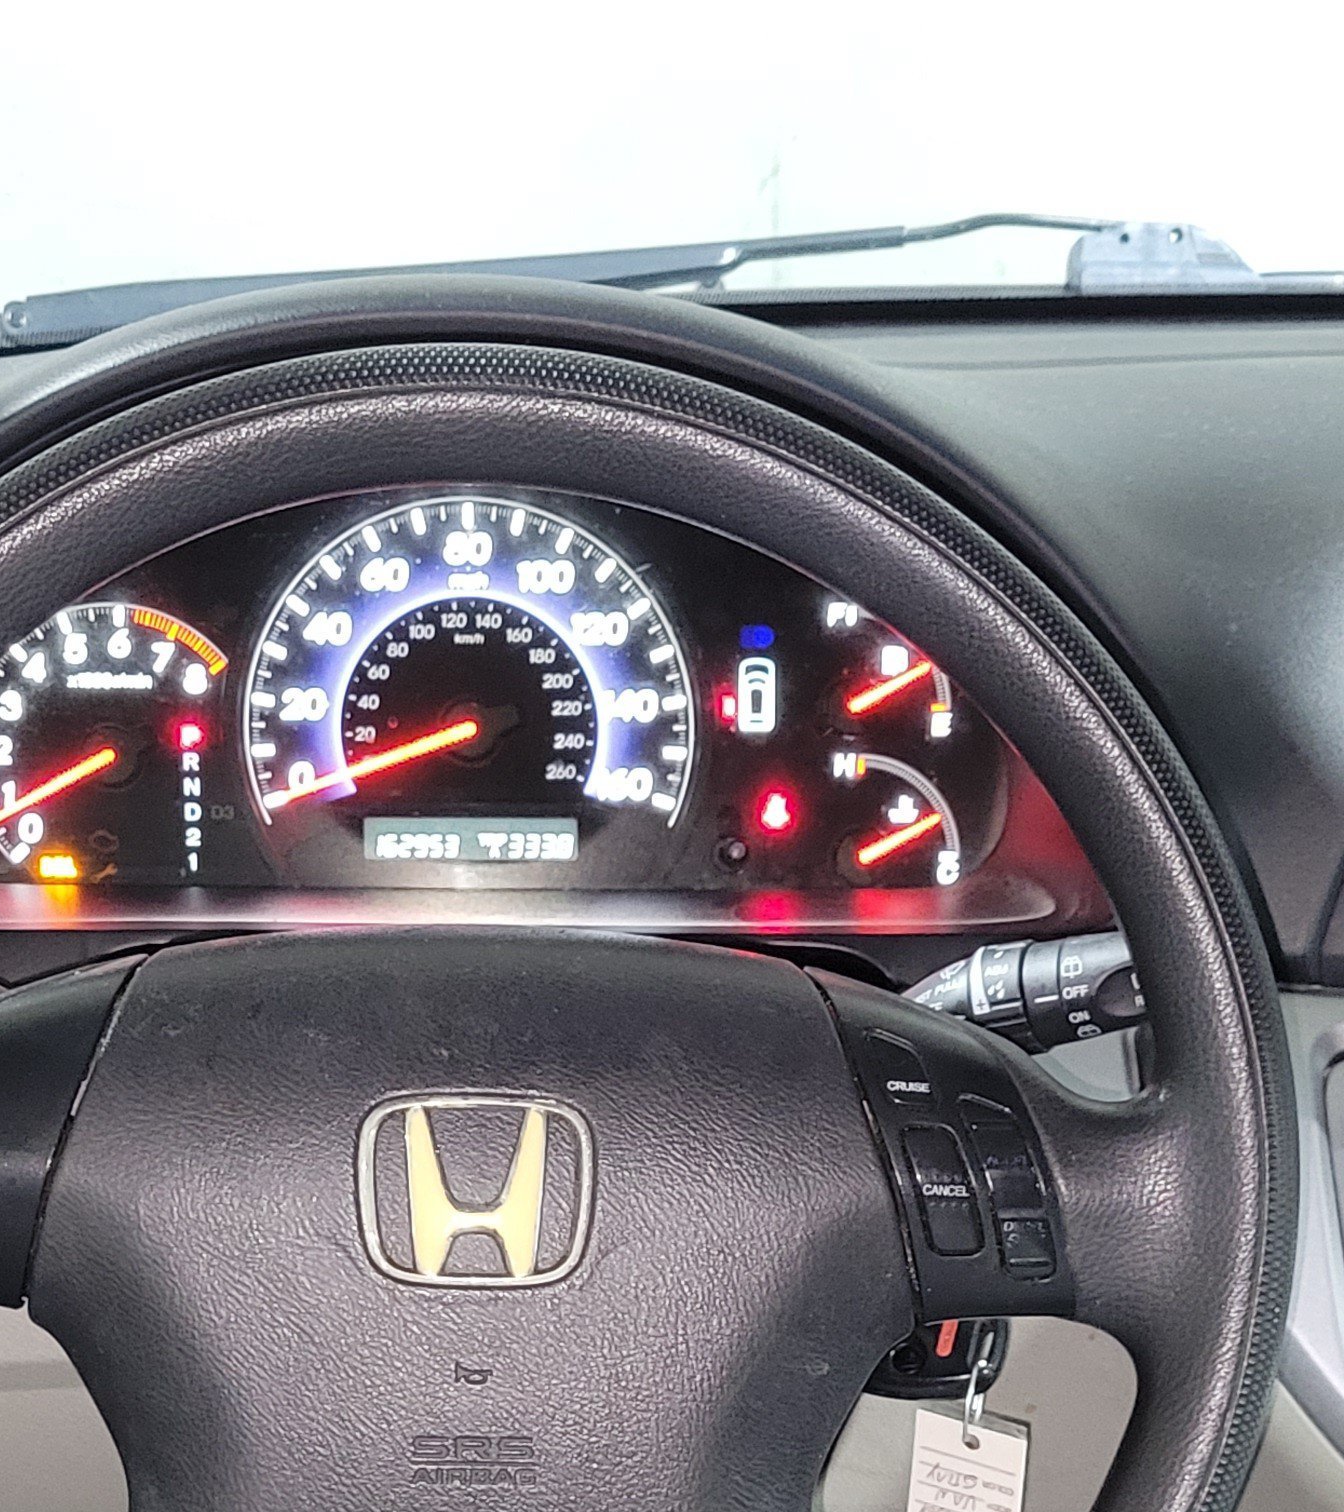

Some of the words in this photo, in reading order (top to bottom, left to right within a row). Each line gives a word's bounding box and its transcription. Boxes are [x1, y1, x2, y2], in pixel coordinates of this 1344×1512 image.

[442, 532, 492, 565] 80
[360, 558, 410, 591] 60
[516, 560, 575, 593] 100
[303, 612, 352, 645] 40
[441, 613, 467, 628] 120
[475, 613, 502, 629] 140
[571, 612, 628, 645] 120
[409, 624, 435, 640] 100
[454, 632, 484, 645] km/h
[506, 627, 532, 643] 160
[63, 633, 88, 664] 5
[108, 629, 131, 658] 6
[386, 643, 409, 658] 80
[151, 642, 176, 672] 7
[529, 649, 555, 664] 180
[22, 653, 47, 683] 4
[367, 665, 390, 681] 60
[183, 664, 207, 694] 8
[542, 673, 574, 690] 200
[280, 688, 329, 720] 20
[357, 695, 380, 710] 40
[551, 701, 582, 717] 220
[600, 689, 658, 722] 140
[354, 727, 376, 742] 20
[930, 711, 953, 738] E
[181, 724, 203, 747] P
[553, 734, 585, 749] 240
[182, 752, 200, 771] R
[833, 752, 856, 778] H
[288, 761, 316, 790] 0
[545, 765, 576, 781] 260
[2, 781, 17, 806] 1
[182, 777, 201, 797] N
[598, 768, 653, 801] 160
[183, 803, 202, 822] D
[17, 813, 43, 844] 0
[185, 828, 202, 848] 2
[187, 852, 198, 872] 1
[936, 858, 961, 886] C
[1062, 984, 1089, 1001] OFF
[1068, 1010, 1091, 1024] ON
[886, 1080, 932, 1093] CRUISE
[922, 1183, 971, 1198] CANCEL
[411, 1435, 535, 1460] SRS
[409, 1467, 538, 1486] AIRBAG
